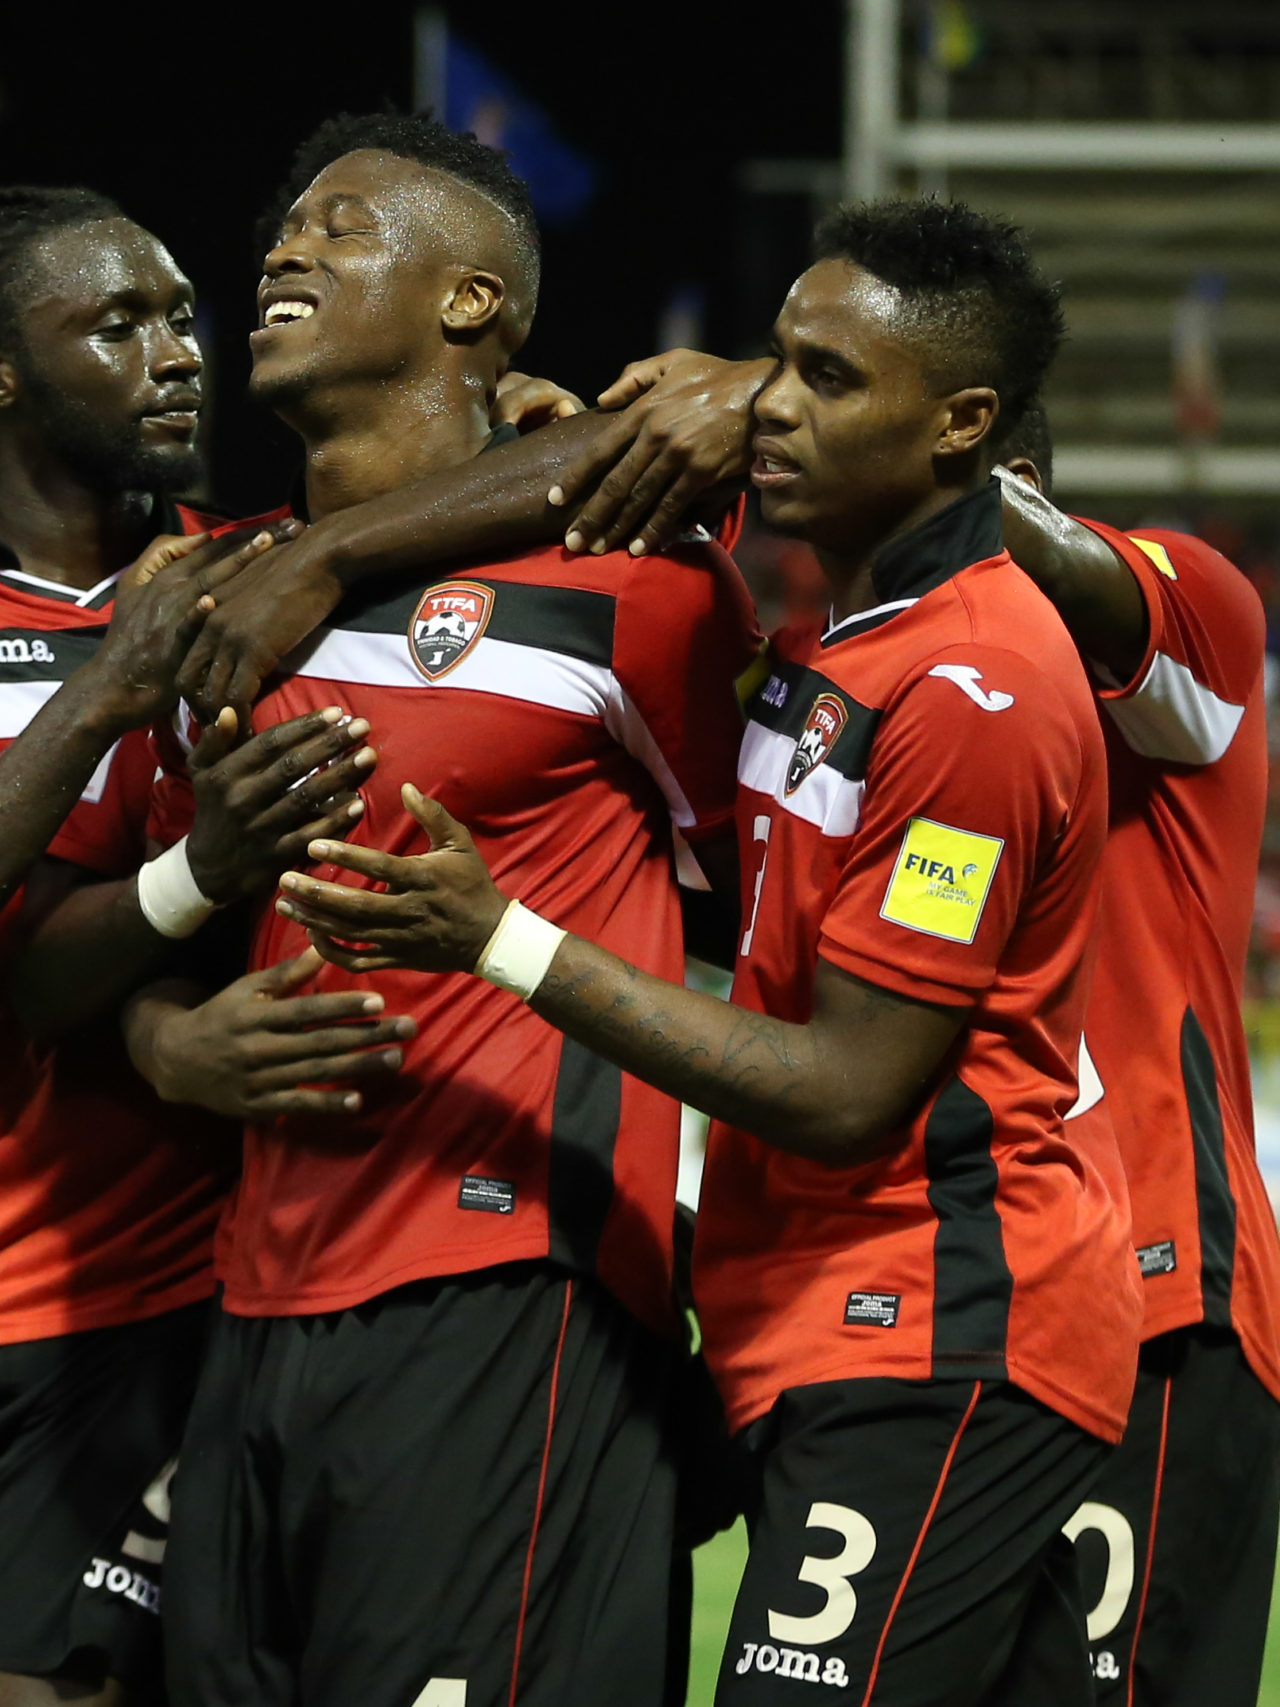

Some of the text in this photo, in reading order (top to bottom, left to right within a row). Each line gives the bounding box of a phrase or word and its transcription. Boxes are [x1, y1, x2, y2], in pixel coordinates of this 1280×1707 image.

[430, 596, 477, 613] TTFA
[814, 708, 837, 736] TTFA
[904, 852, 956, 886] FIFA
[768, 1502, 877, 1645] 3
